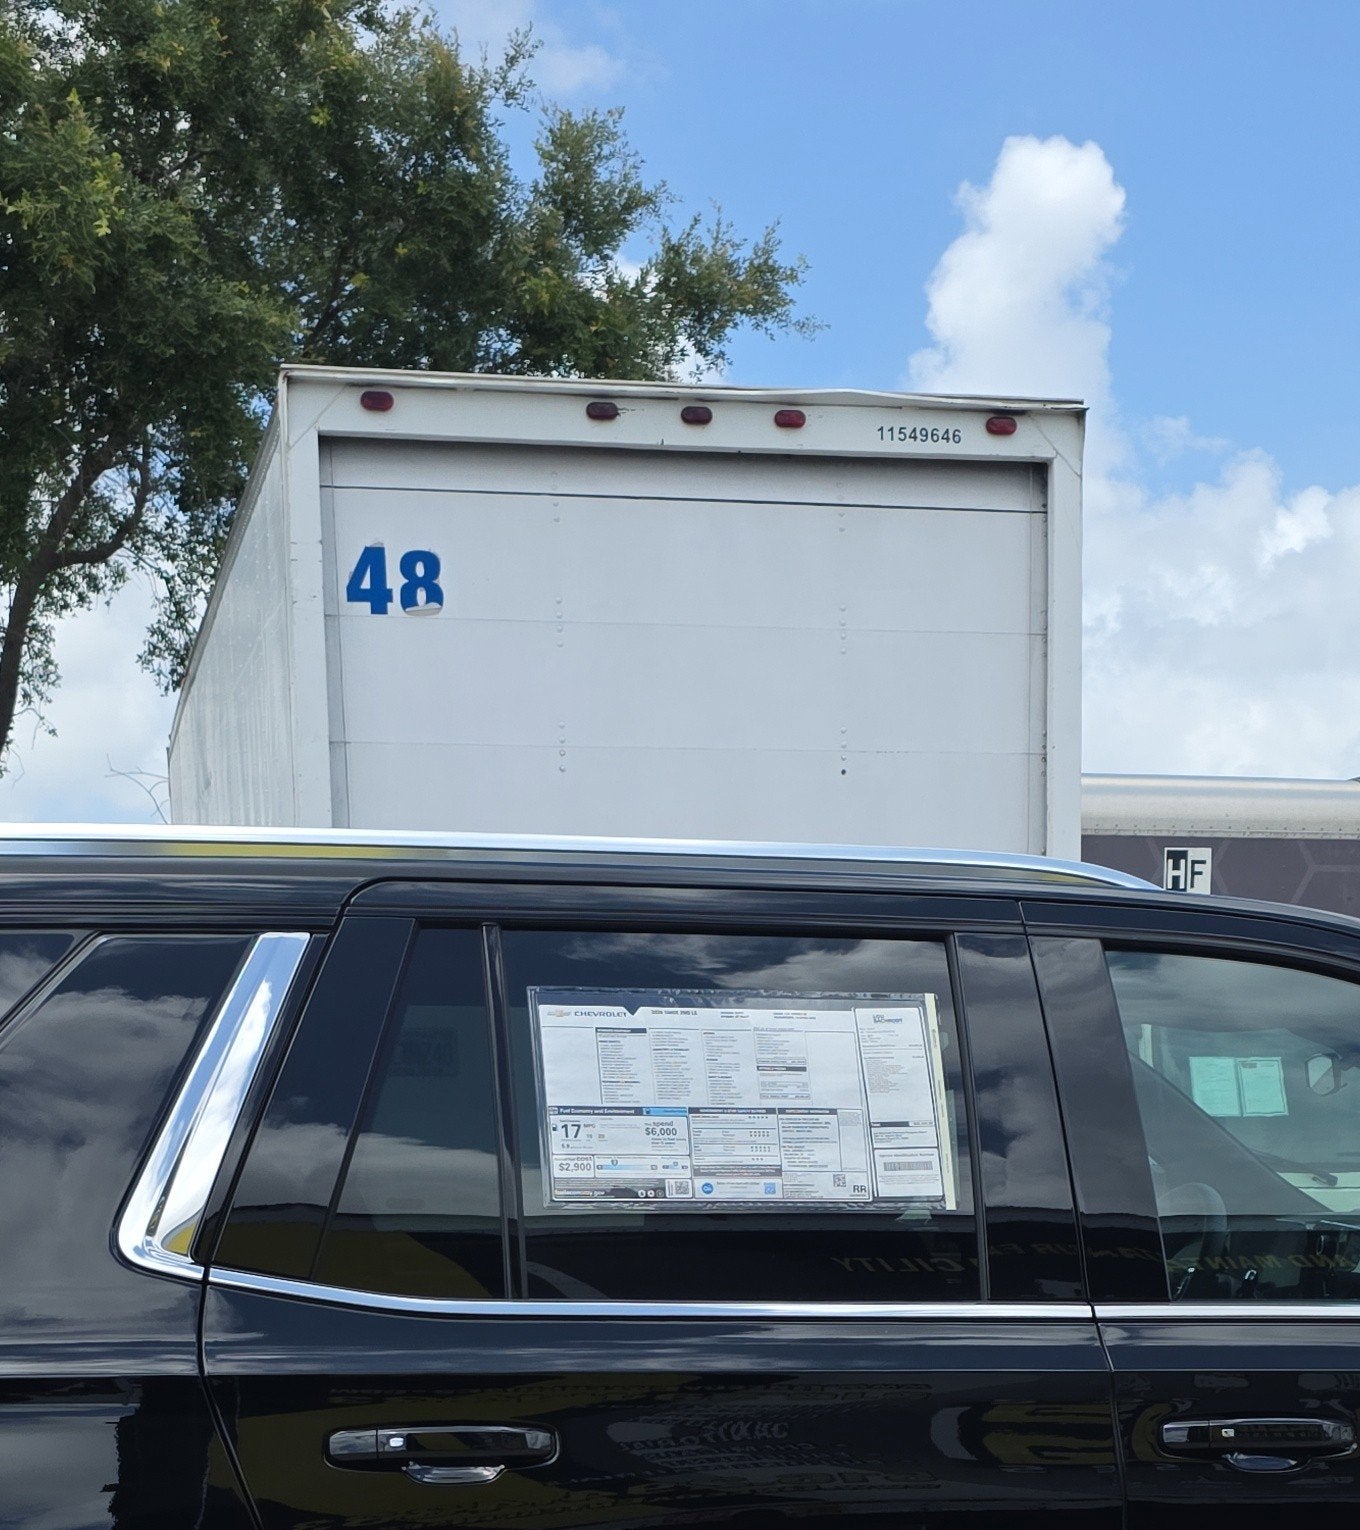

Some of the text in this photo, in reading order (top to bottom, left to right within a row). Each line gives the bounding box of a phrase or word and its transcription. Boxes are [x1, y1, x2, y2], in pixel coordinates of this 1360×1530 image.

[877, 426, 962, 444] 11549646
[346, 545, 444, 617] 48
[1167, 858, 1207, 889] HF
[561, 1123, 581, 1139] 17
[645, 1127, 678, 1136] $6,000
[559, 1162, 592, 1172] $2,900
[853, 1185, 867, 1193] RR
